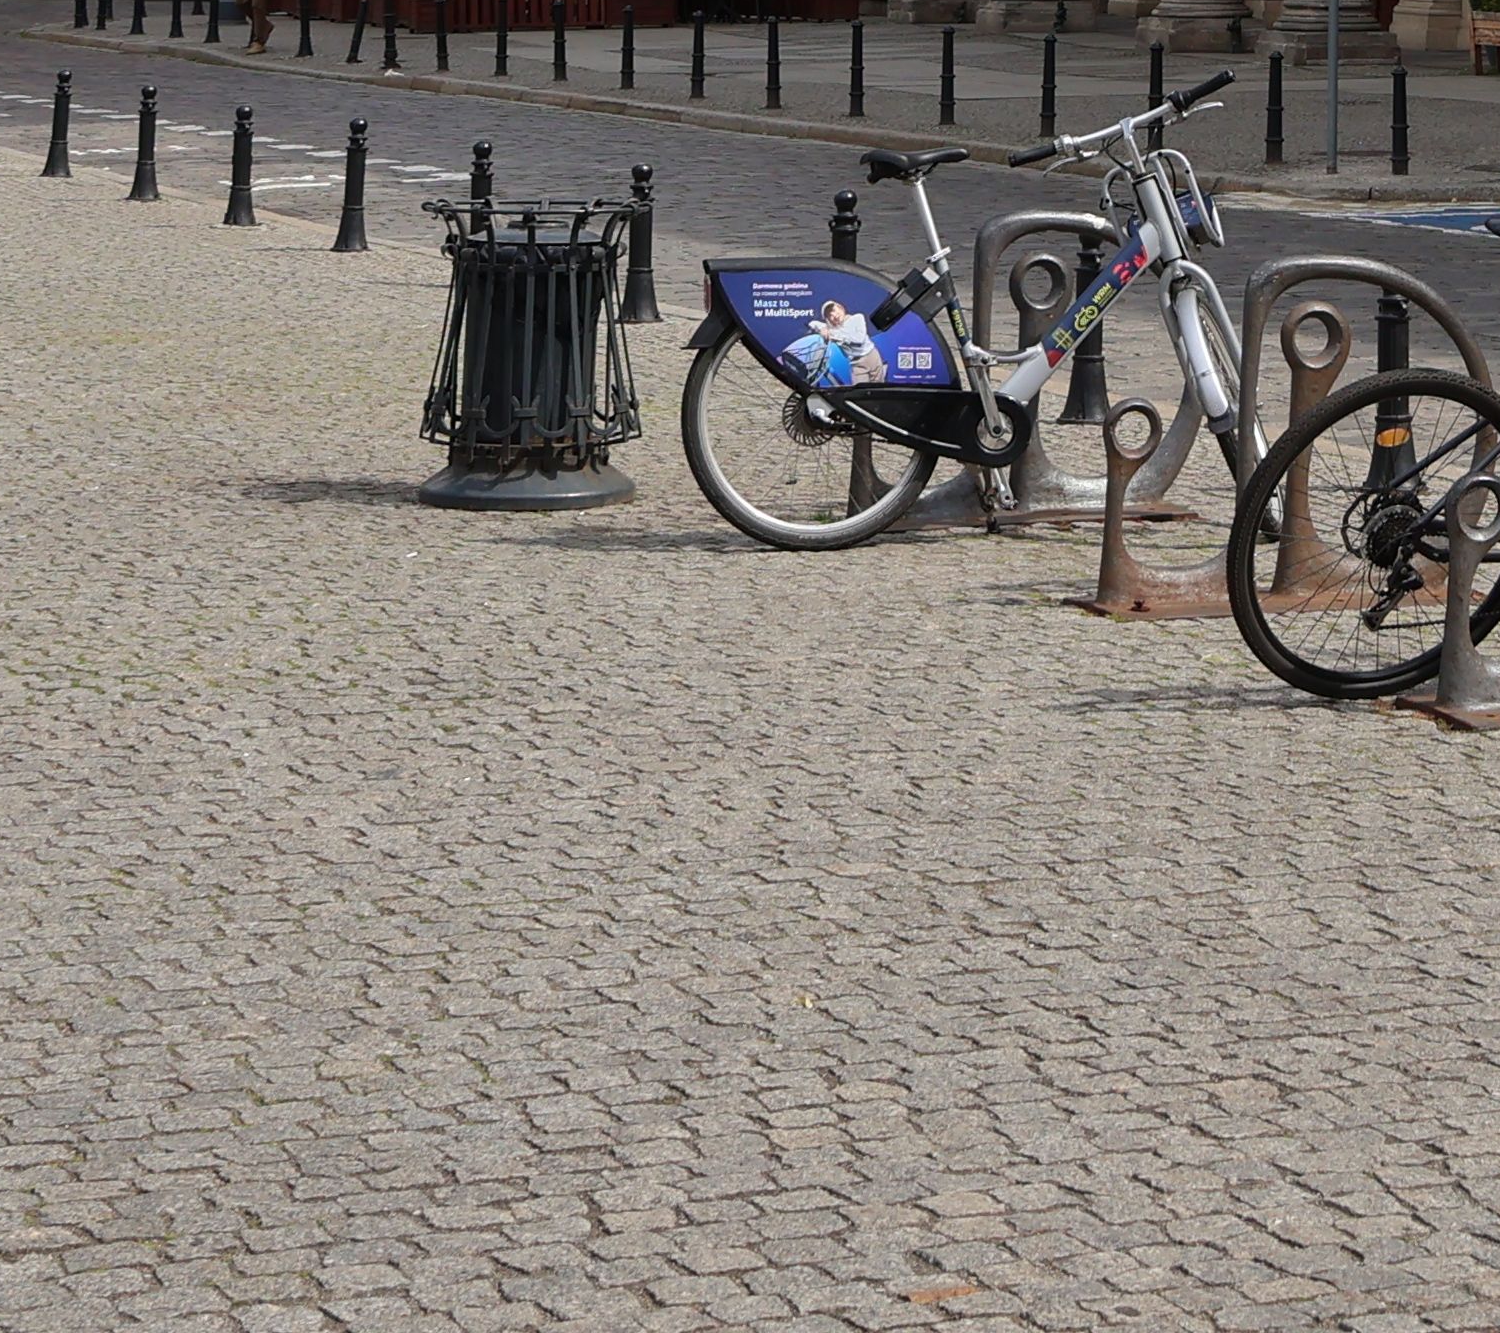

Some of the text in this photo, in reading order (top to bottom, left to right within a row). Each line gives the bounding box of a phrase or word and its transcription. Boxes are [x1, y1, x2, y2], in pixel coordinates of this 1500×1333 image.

[1092, 282, 1114, 304] WRM
[754, 299, 790, 308] Masz to
[765, 308, 815, 319] MultiSport
